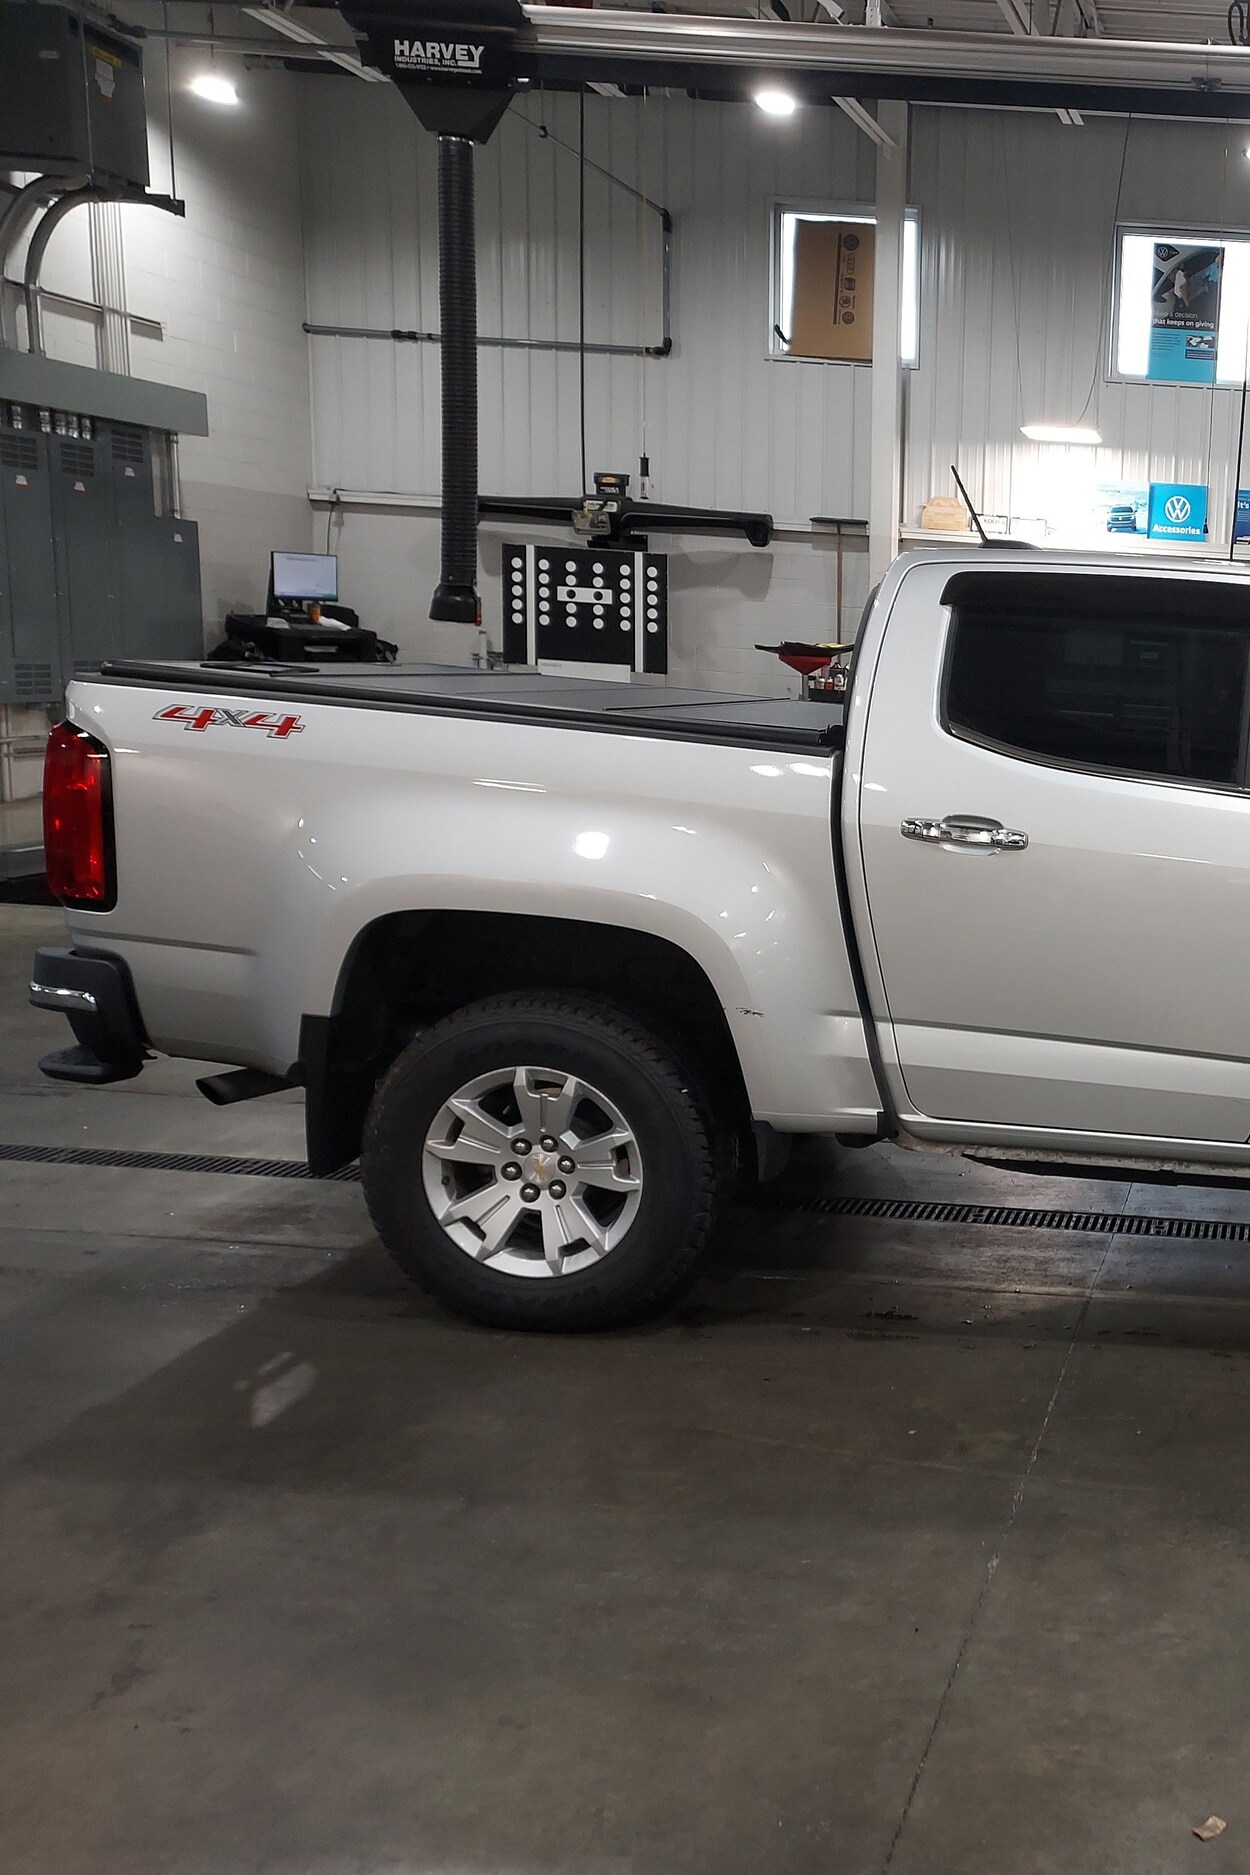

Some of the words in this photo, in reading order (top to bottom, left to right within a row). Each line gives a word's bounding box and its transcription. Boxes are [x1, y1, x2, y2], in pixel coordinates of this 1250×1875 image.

[394, 39, 485, 68] HARVEY
[442, 59, 457, 67] INC.
[1167, 318, 1185, 327] keeps
[1195, 320, 1215, 329] giving
[1152, 523, 1201, 535] Accessories
